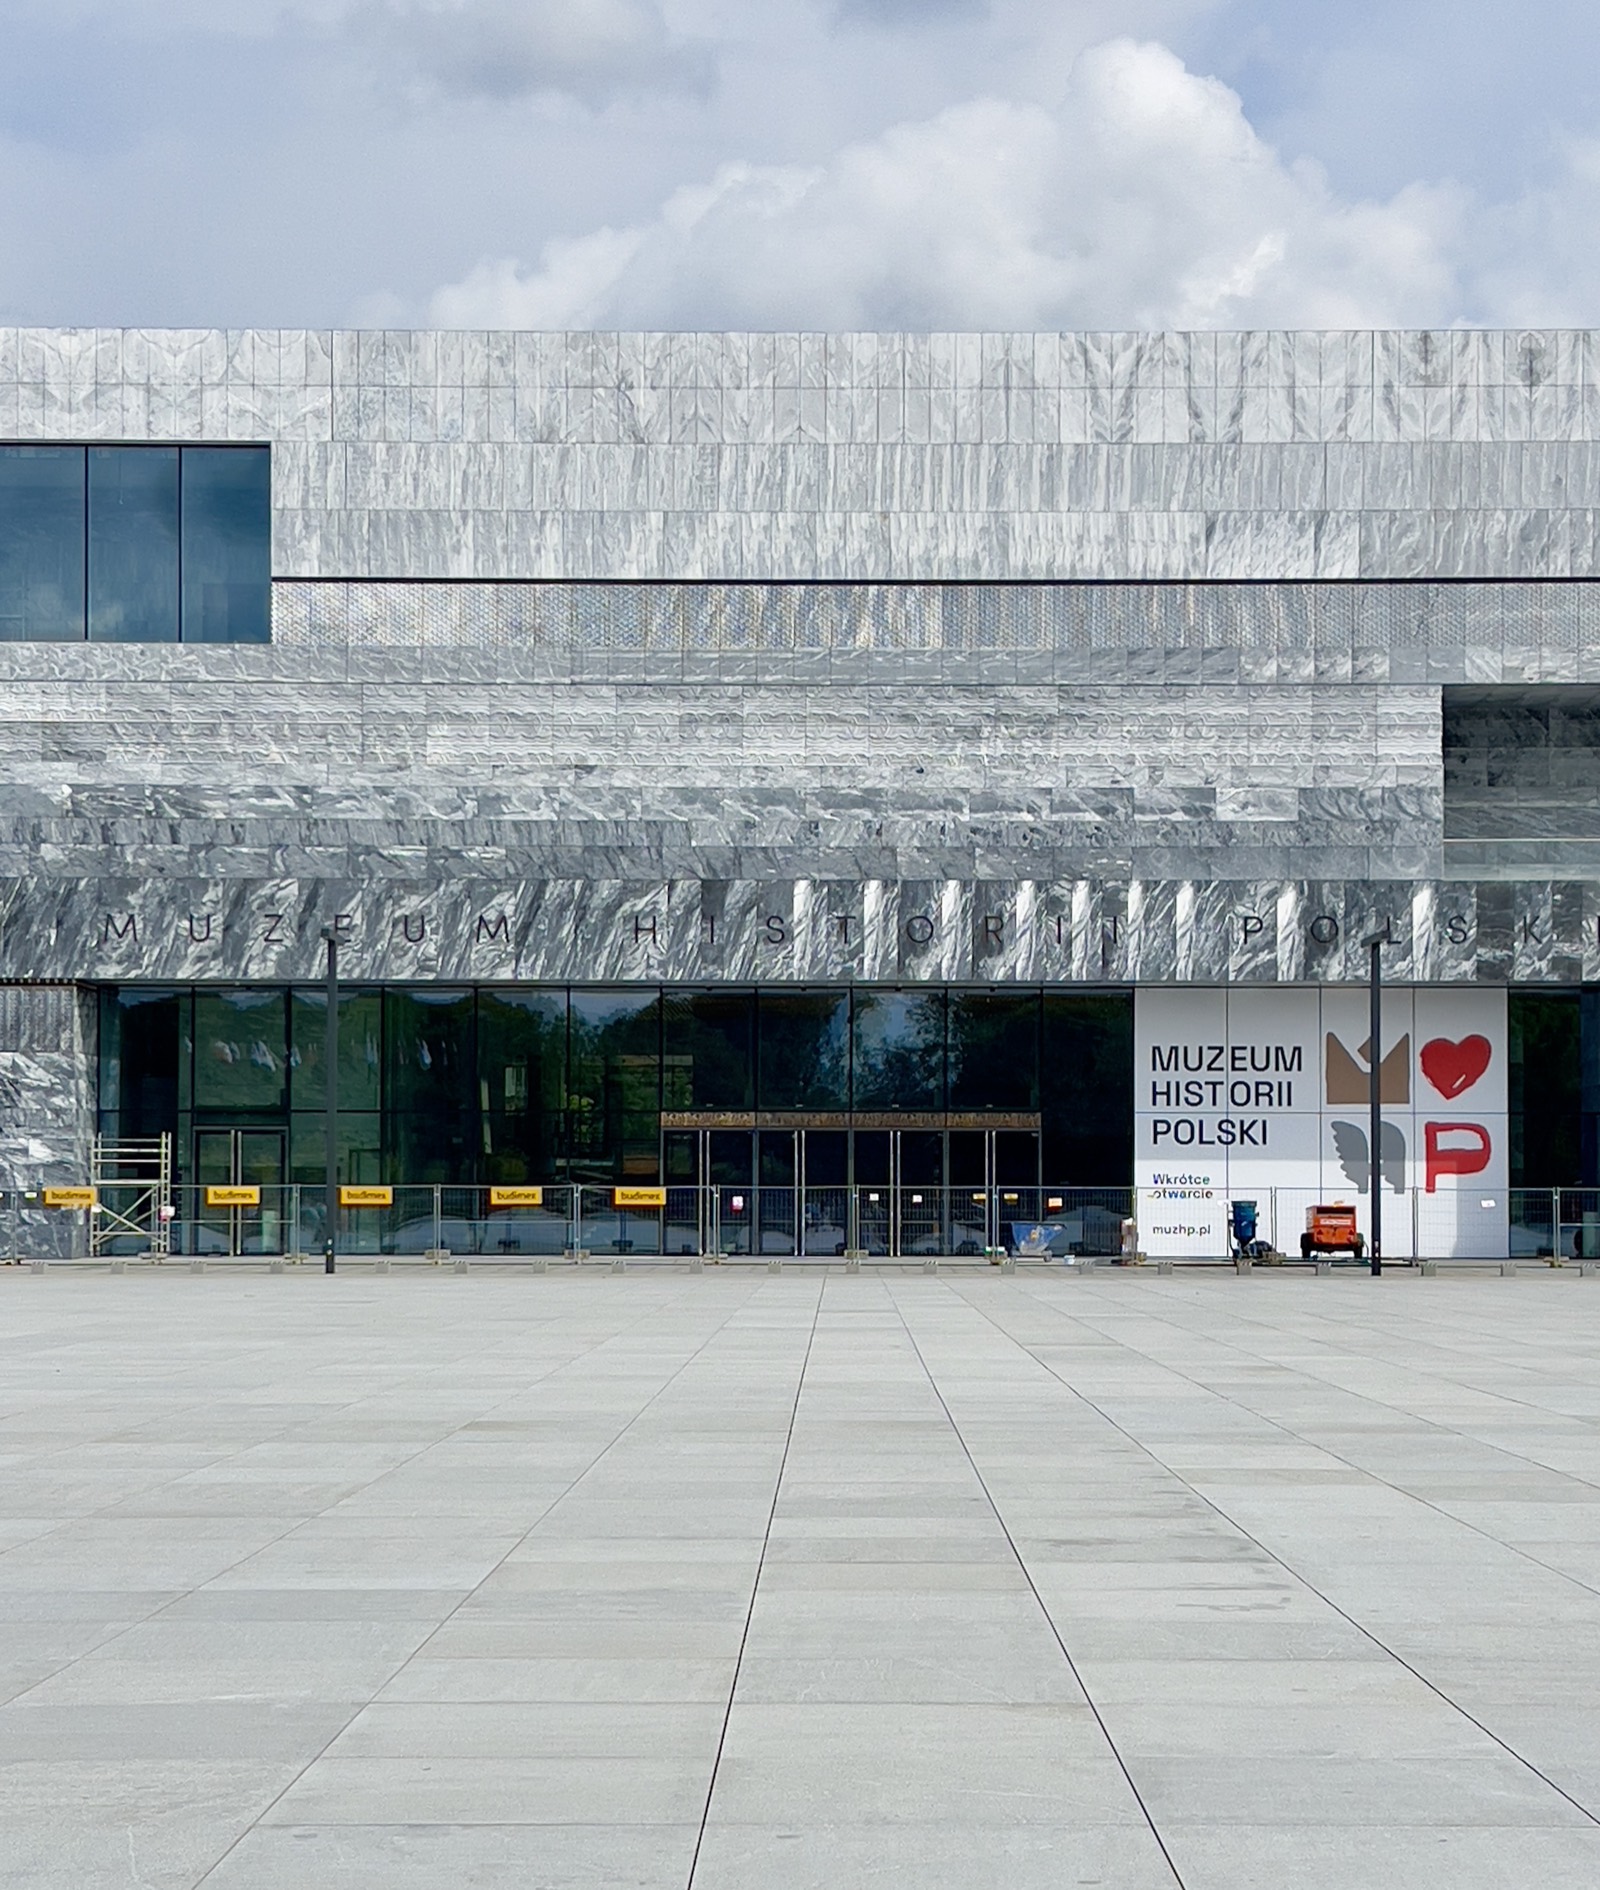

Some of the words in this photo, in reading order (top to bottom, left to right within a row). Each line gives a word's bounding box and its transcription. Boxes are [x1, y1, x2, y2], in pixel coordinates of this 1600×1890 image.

[105, 914, 512, 944] MUZEUM
[635, 914, 1120, 945] HISTORII
[1151, 1045, 1303, 1073] MUZEUM
[1151, 1080, 1293, 1107] HISTORII
[1151, 1118, 1268, 1146] POLSKI
[1152, 1173, 1211, 1185] Wkrótce
[496, 1190, 537, 1201] budimex
[621, 1190, 662, 1201] budimex
[1152, 1188, 1213, 1199] otwarcie
[1152, 1224, 1211, 1237] muzhp.pl
